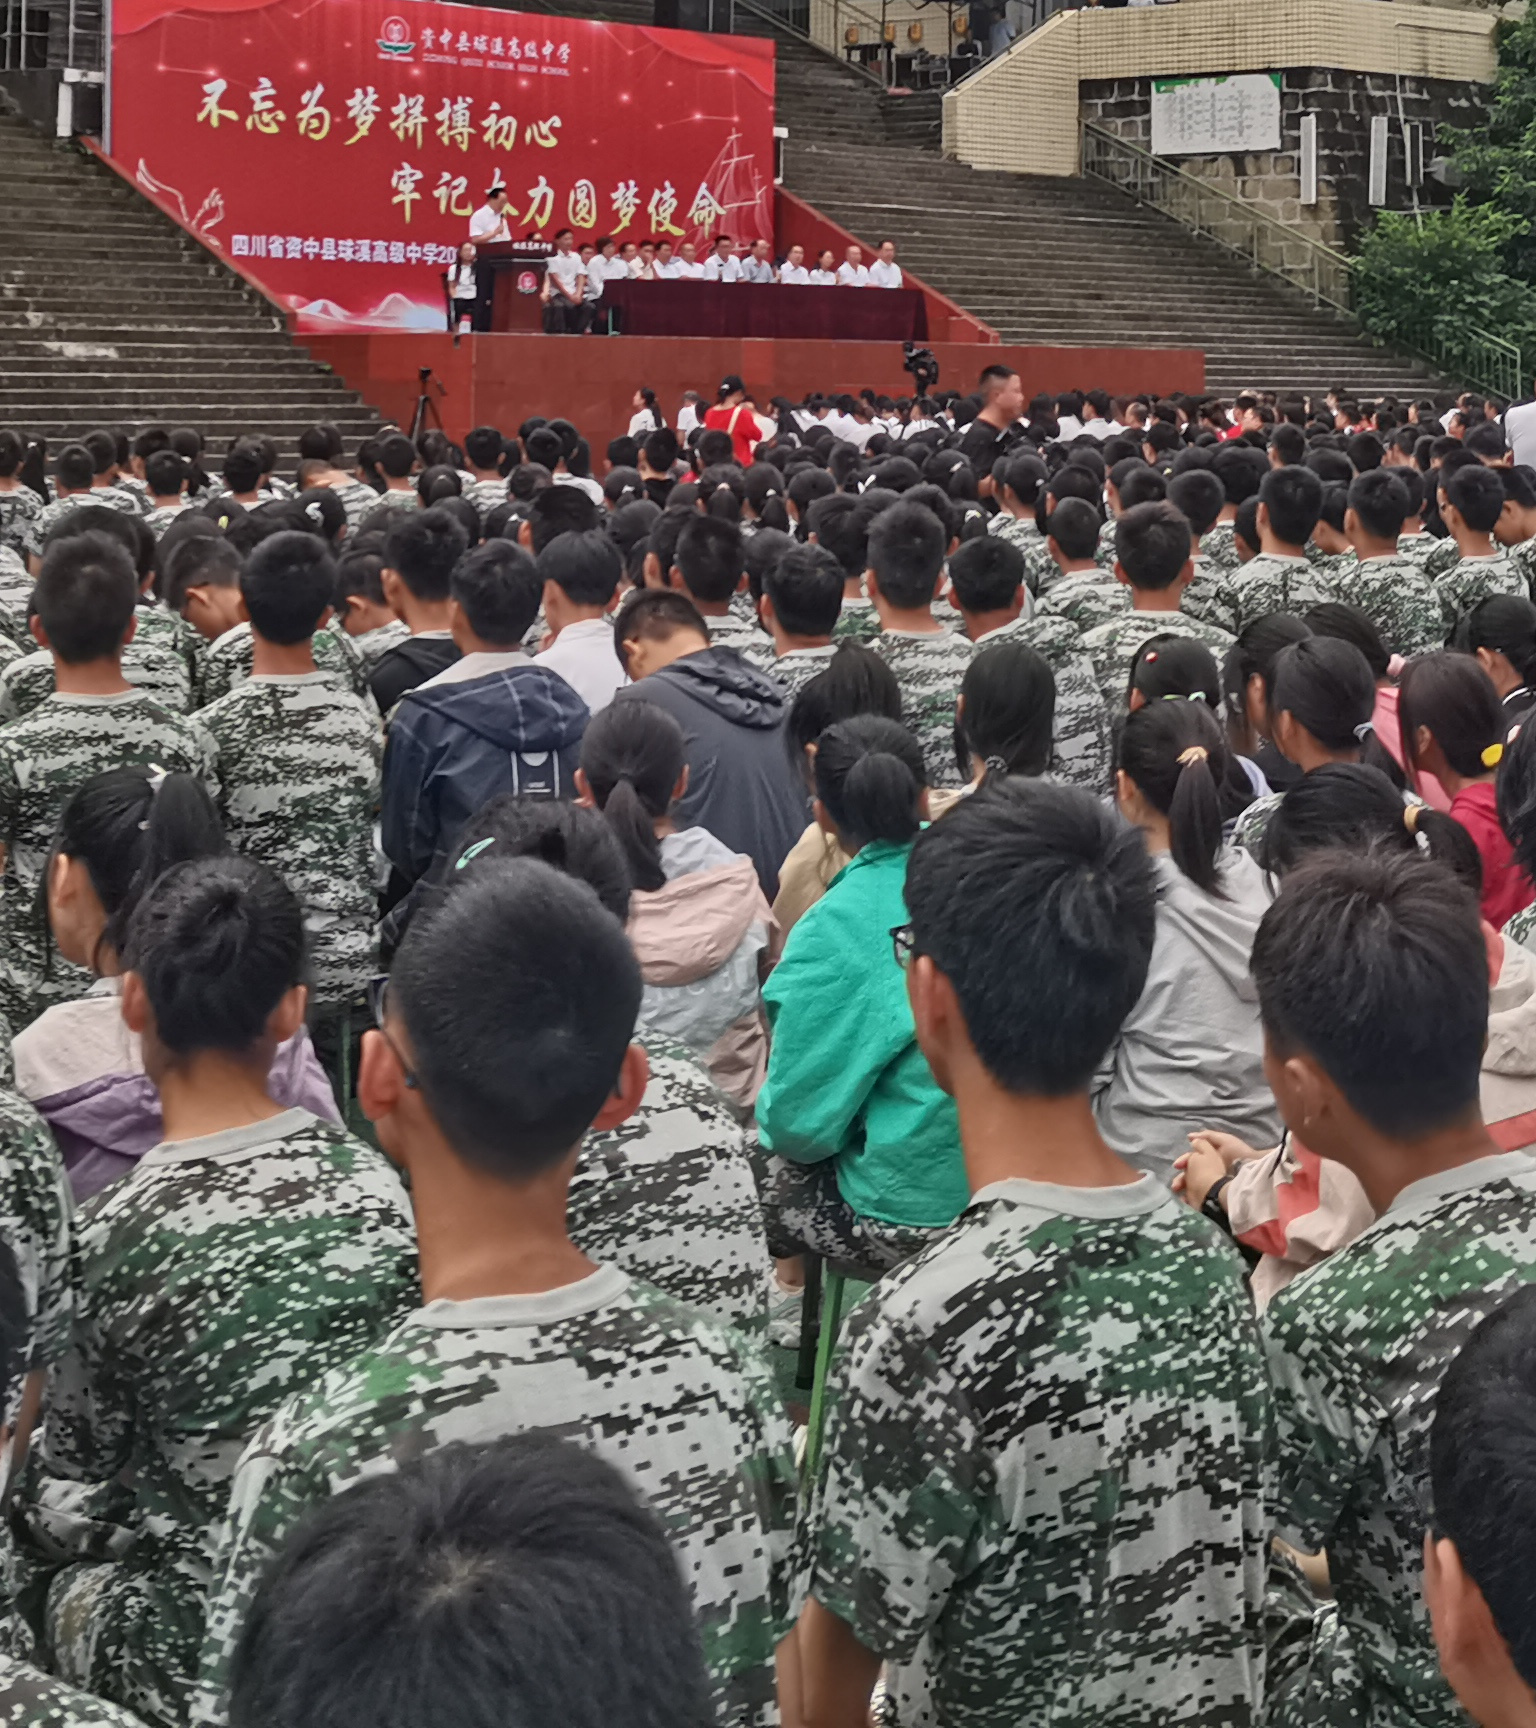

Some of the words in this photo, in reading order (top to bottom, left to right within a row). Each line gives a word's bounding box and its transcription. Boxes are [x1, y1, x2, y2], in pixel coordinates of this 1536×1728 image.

[421, 26, 571, 64] 资中县球溪高级中学
[196, 76, 563, 153] 不忘为梦拼搏初心
